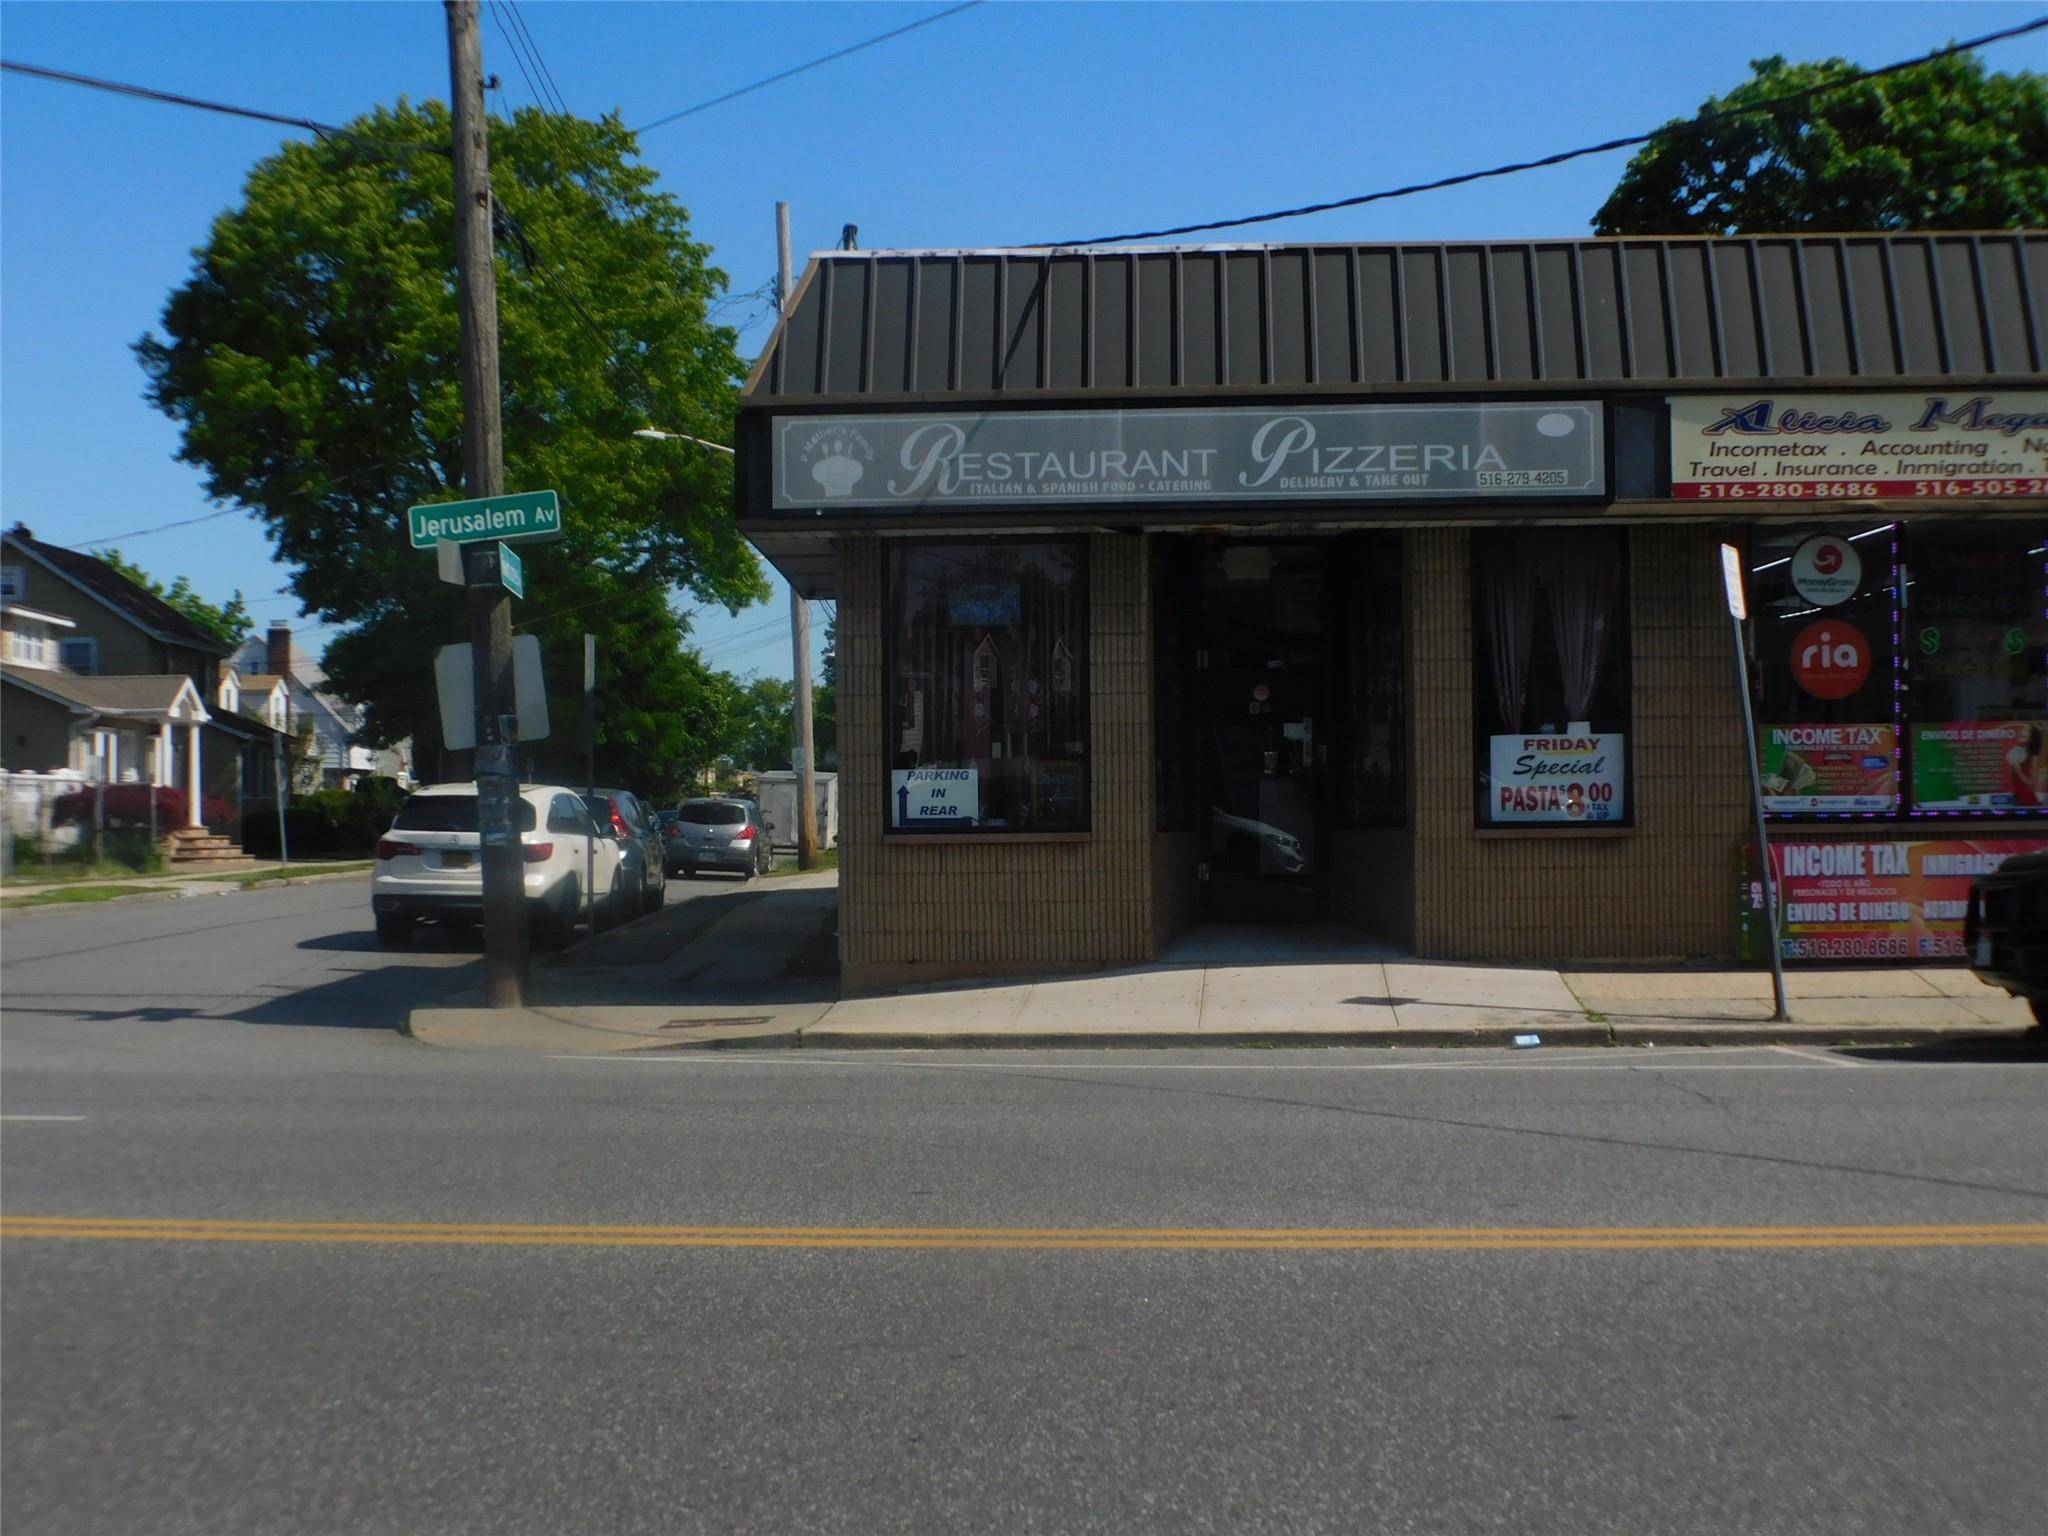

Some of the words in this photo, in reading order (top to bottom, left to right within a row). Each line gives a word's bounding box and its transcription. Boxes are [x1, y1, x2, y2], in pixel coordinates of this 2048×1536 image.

[1701, 399, 1892, 436] Alicia
[1708, 441, 1828, 457] Incometax
[1859, 439, 1988, 457] Accounting
[1689, 461, 1757, 477] Travel
[1775, 460, 1877, 476] Insurance
[1896, 458, 2023, 479] Inmigration
[970, 482, 1022, 494] ITALIAN
[1027, 482, 1037, 494] &
[1042, 481, 1098, 493] SPANISH
[1102, 481, 1136, 493] FOOD
[1148, 479, 1211, 492] CATERING
[1279, 475, 1345, 488] DELIVERY
[1349, 475, 1359, 487] &
[1365, 474, 1399, 486] TAKE
[1402, 473, 1429, 486] OUT
[1479, 471, 1565, 485] 516-279-4205
[1699, 483, 1878, 498] 516-280-8686
[414, 508, 525, 539] Jerusalem
[535, 506, 555, 524] Av
[1802, 631, 1859, 669] ria
[1524, 737, 1601, 751] FRIDAY
[1772, 728, 1843, 746] INCOME
[1846, 727, 1882, 745] TAX
[907, 770, 970, 781] PARKING
[1512, 755, 1606, 780] Special
[931, 788, 946, 799] IN
[1501, 785, 1561, 812] PASTA
[919, 805, 958, 816] REAR
[1784, 845, 1865, 877] INCOME
[1869, 844, 1910, 876] TAX
[1786, 902, 1836, 922] ENVIOS
[1839, 902, 1857, 922] DE
[1859, 901, 1910, 921] DINERO
